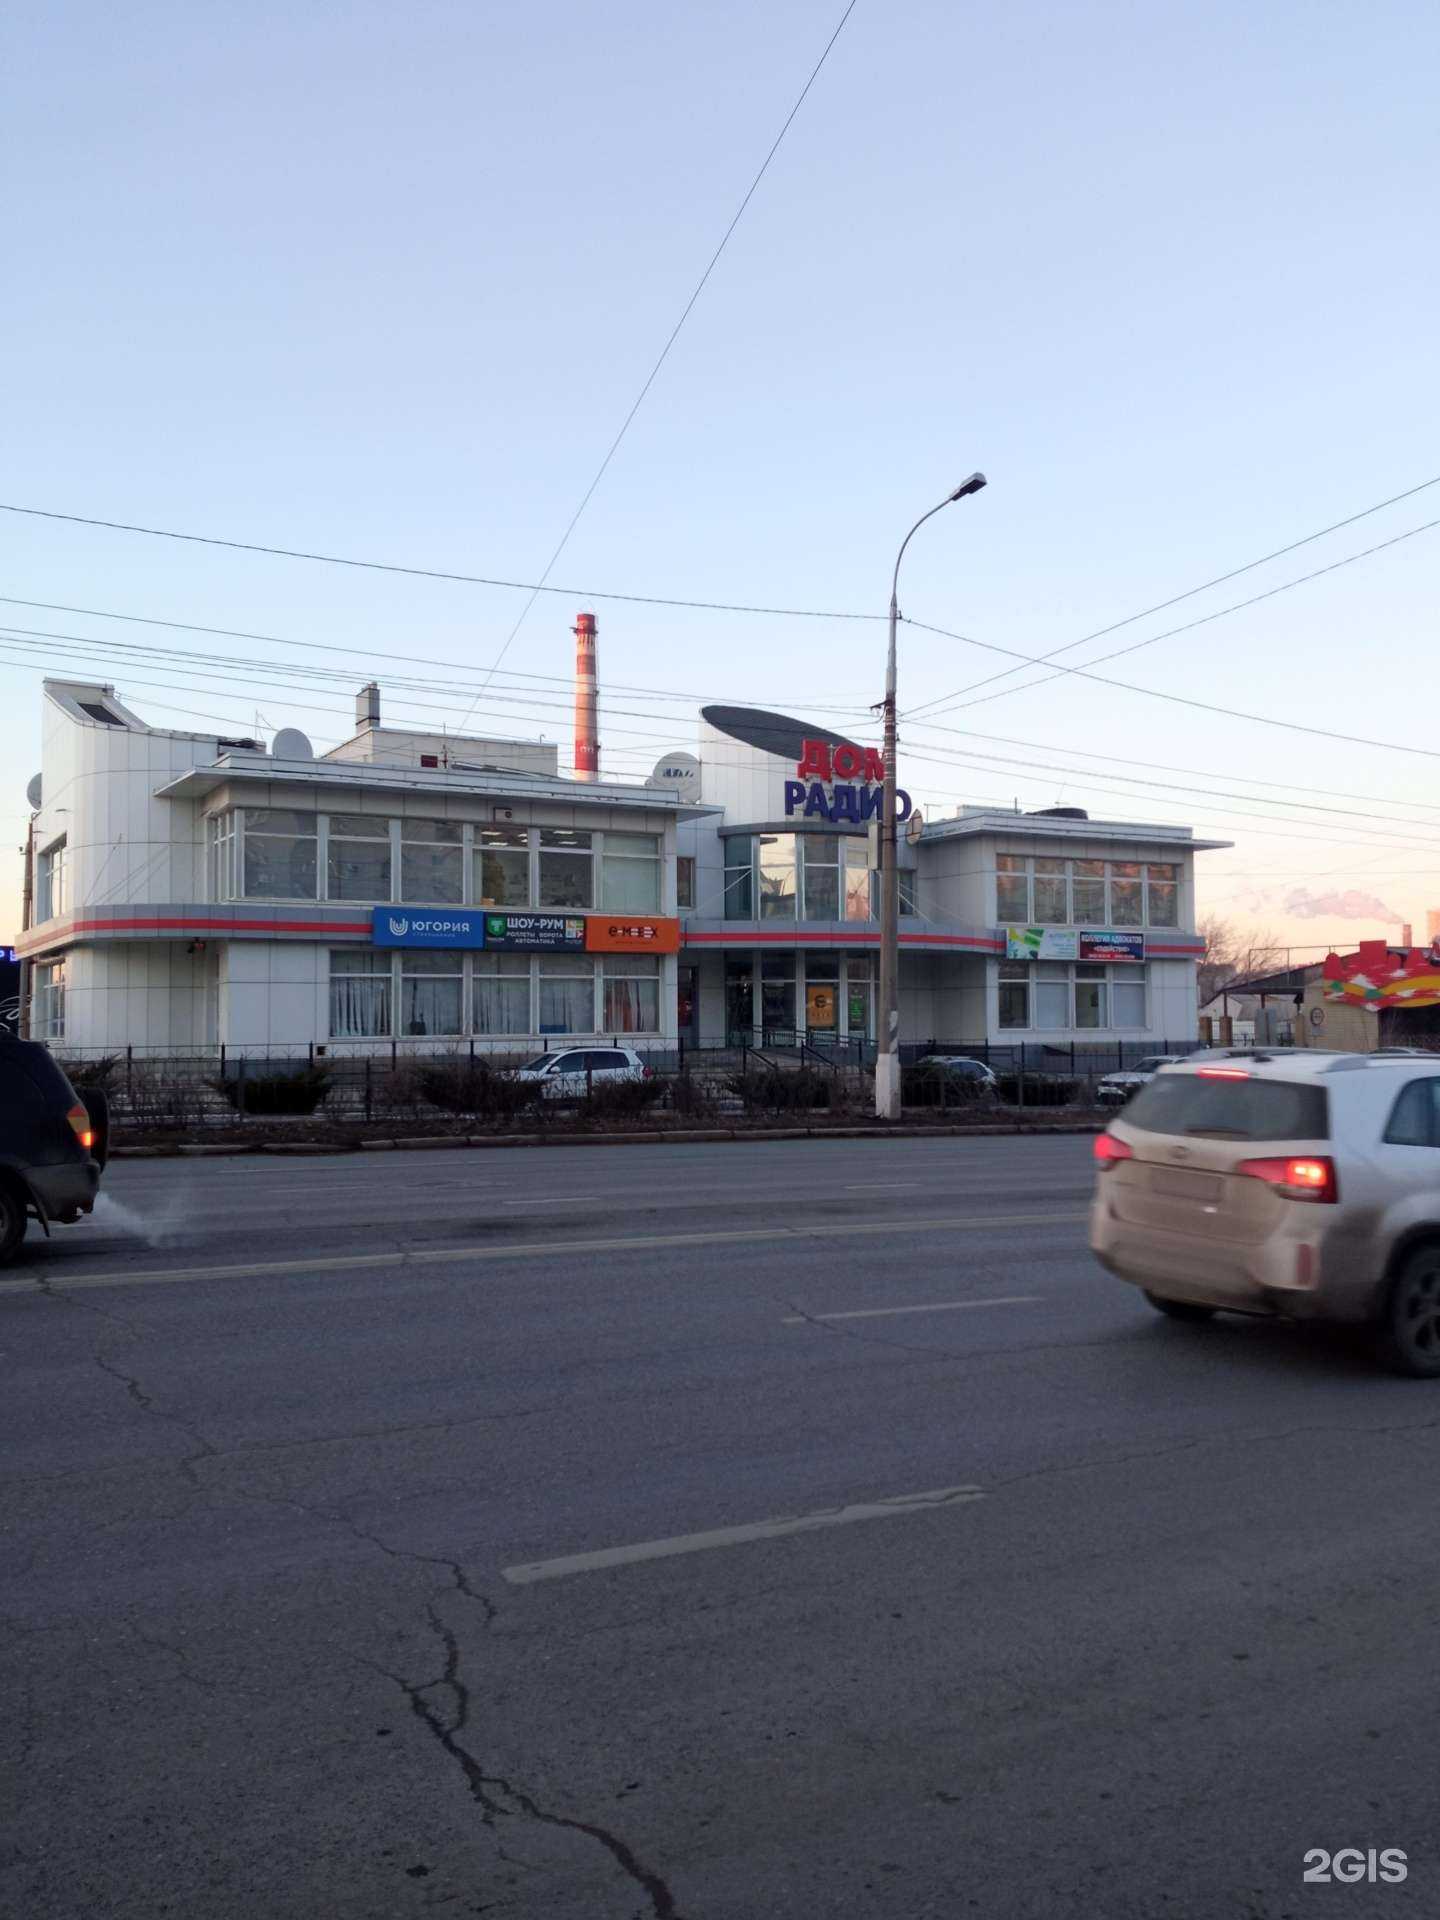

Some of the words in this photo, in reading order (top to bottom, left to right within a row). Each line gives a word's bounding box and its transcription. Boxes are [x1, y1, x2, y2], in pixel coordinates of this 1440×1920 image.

[785, 781, 912, 823] РАДИО
[411, 921, 470, 932] ЮГОРИЯ
[506, 917, 564, 929] ШОУ-РУМ
[1111, 935, 1143, 944] АДВОКАТОВ
